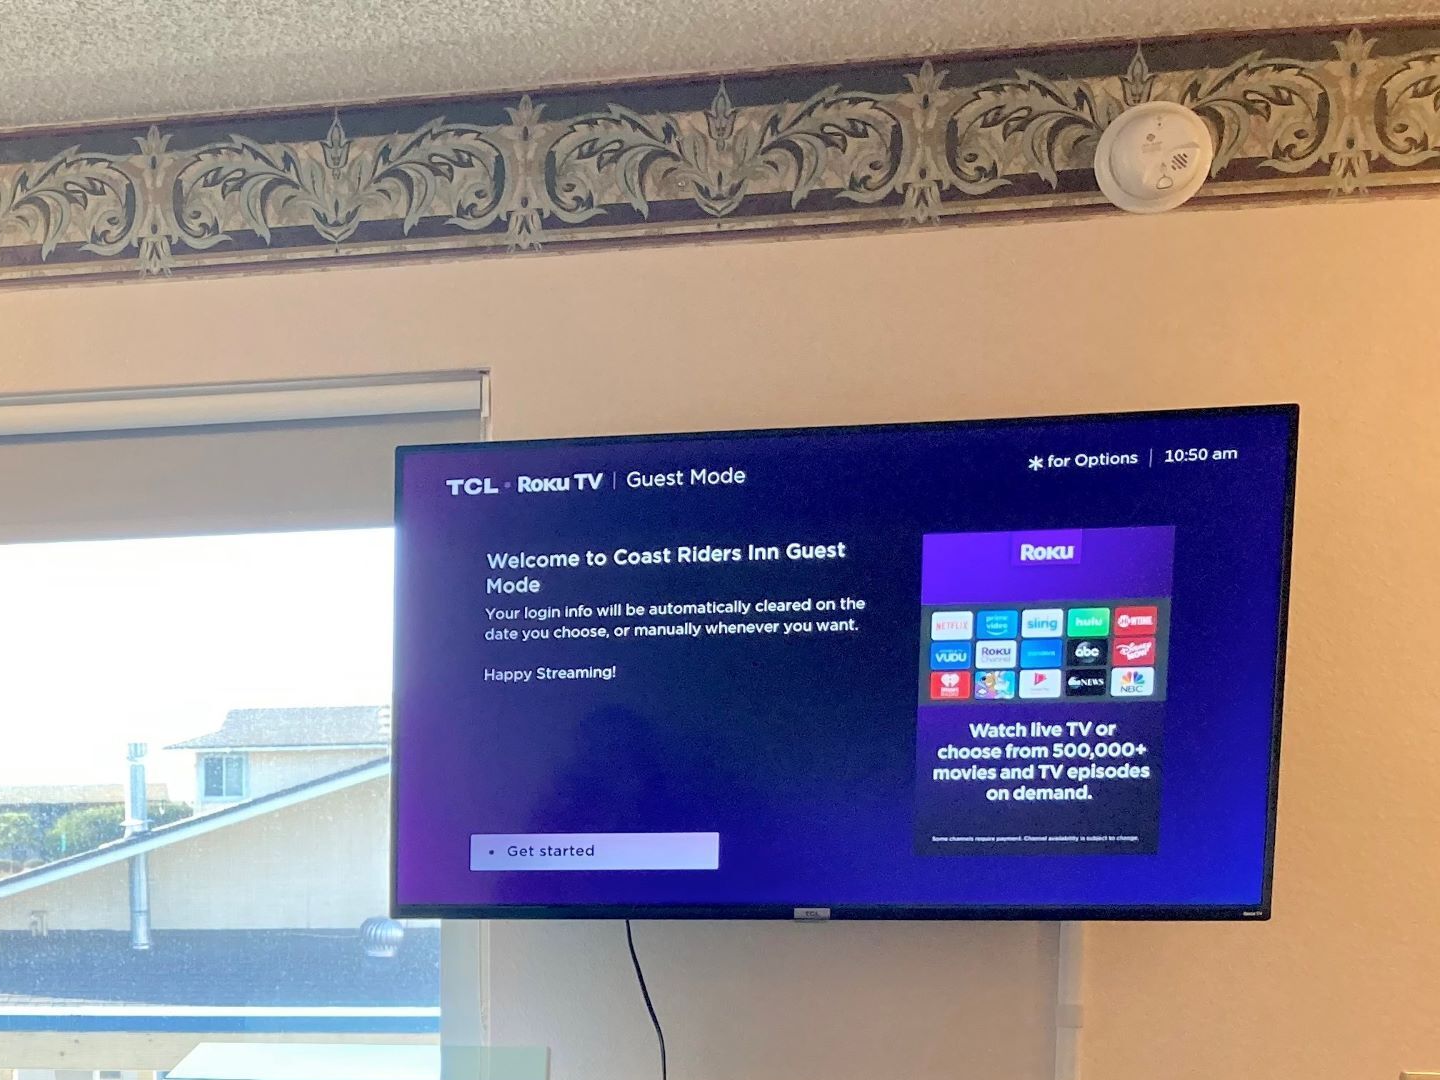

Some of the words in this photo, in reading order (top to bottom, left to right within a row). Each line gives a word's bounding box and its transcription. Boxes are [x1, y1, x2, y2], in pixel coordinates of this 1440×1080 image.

[1048, 454, 1070, 468] for
[1075, 452, 1138, 468] Options
[1164, 448, 1208, 462] 10:50
[1212, 449, 1238, 460] am
[446, 478, 499, 495] TCL
[518, 476, 570, 493] Roku
[574, 473, 603, 490] TV
[626, 470, 683, 487] Guest
[690, 467, 746, 485] Mode
[487, 552, 580, 569] Welcome
[586, 550, 607, 566] to
[613, 548, 671, 565] Coast
[678, 545, 742, 562] Riders
[748, 544, 779, 560] Inn
[786, 542, 846, 559] Guest
[1020, 544, 1074, 560] Roku
[486, 577, 540, 594] Mode
[485, 607, 520, 620] Your
[524, 606, 560, 621] login
[565, 604, 592, 618] info
[597, 604, 621, 616] will
[625, 603, 645, 616] be
[648, 600, 750, 615] automatically
[755, 598, 811, 612] cleared
[816, 600, 836, 611] on
[840, 597, 866, 609] the
[485, 628, 518, 641] date
[522, 629, 549, 641] you
[553, 626, 610, 639] choose,
[613, 626, 630, 637] or
[634, 622, 702, 637] manually
[705, 621, 779, 634] whenever
[784, 620, 812, 634] you
[816, 618, 859, 631] want.
[936, 620, 968, 631] NETFLIX
[1028, 618, 1057, 631] sling
[1076, 617, 1102, 627] hulu
[935, 652, 967, 662] VUDU
[1075, 646, 1099, 657] abc
[484, 668, 532, 682] Happy
[536, 666, 616, 680] Streaming!
[969, 722, 1027, 738] Watch
[1031, 722, 1062, 737] live
[1066, 721, 1092, 736] TV
[1095, 723, 1116, 736] or
[937, 744, 1002, 760] choose
[1005, 743, 1049, 758] from
[1052, 742, 1146, 760] 500,000+
[932, 765, 996, 780] movies
[1000, 764, 1034, 779] and
[1038, 764, 1063, 779] TV
[1067, 763, 1150, 781] episodes
[986, 788, 1009, 800] on
[1013, 785, 1092, 800] demand.
[507, 846, 534, 857] Get
[540, 845, 595, 856] started
